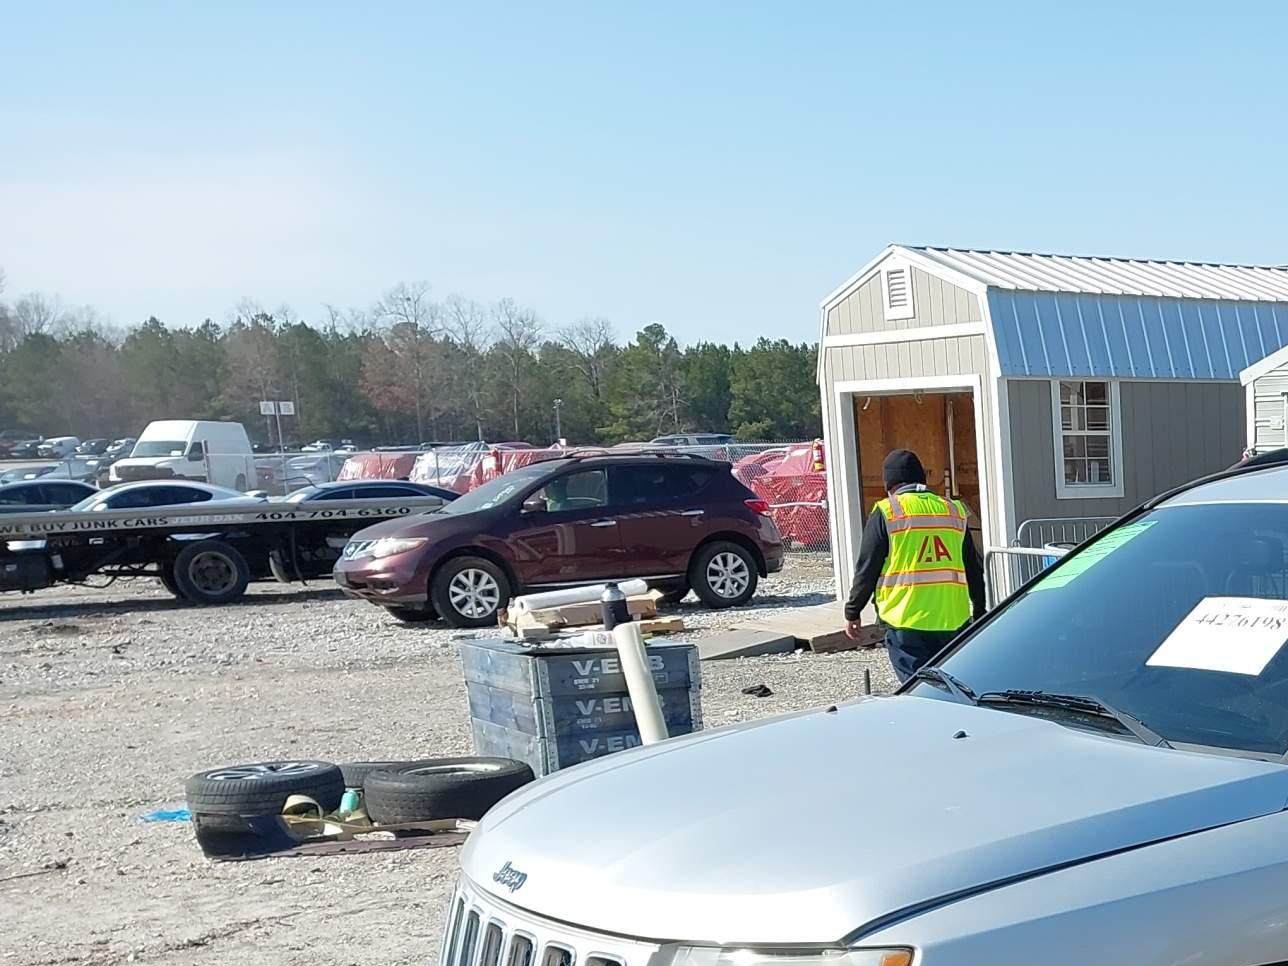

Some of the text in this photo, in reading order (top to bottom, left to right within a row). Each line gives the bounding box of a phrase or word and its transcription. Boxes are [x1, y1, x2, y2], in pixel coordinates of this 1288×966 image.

[30, 522, 66, 532] BUY
[71, 519, 119, 530] JUNK
[123, 516, 168, 527] CARS
[255, 507, 411, 521] 404-704-6360
[1195, 613, 1287, 631] 44276198
[572, 655, 665, 676] V-EB
